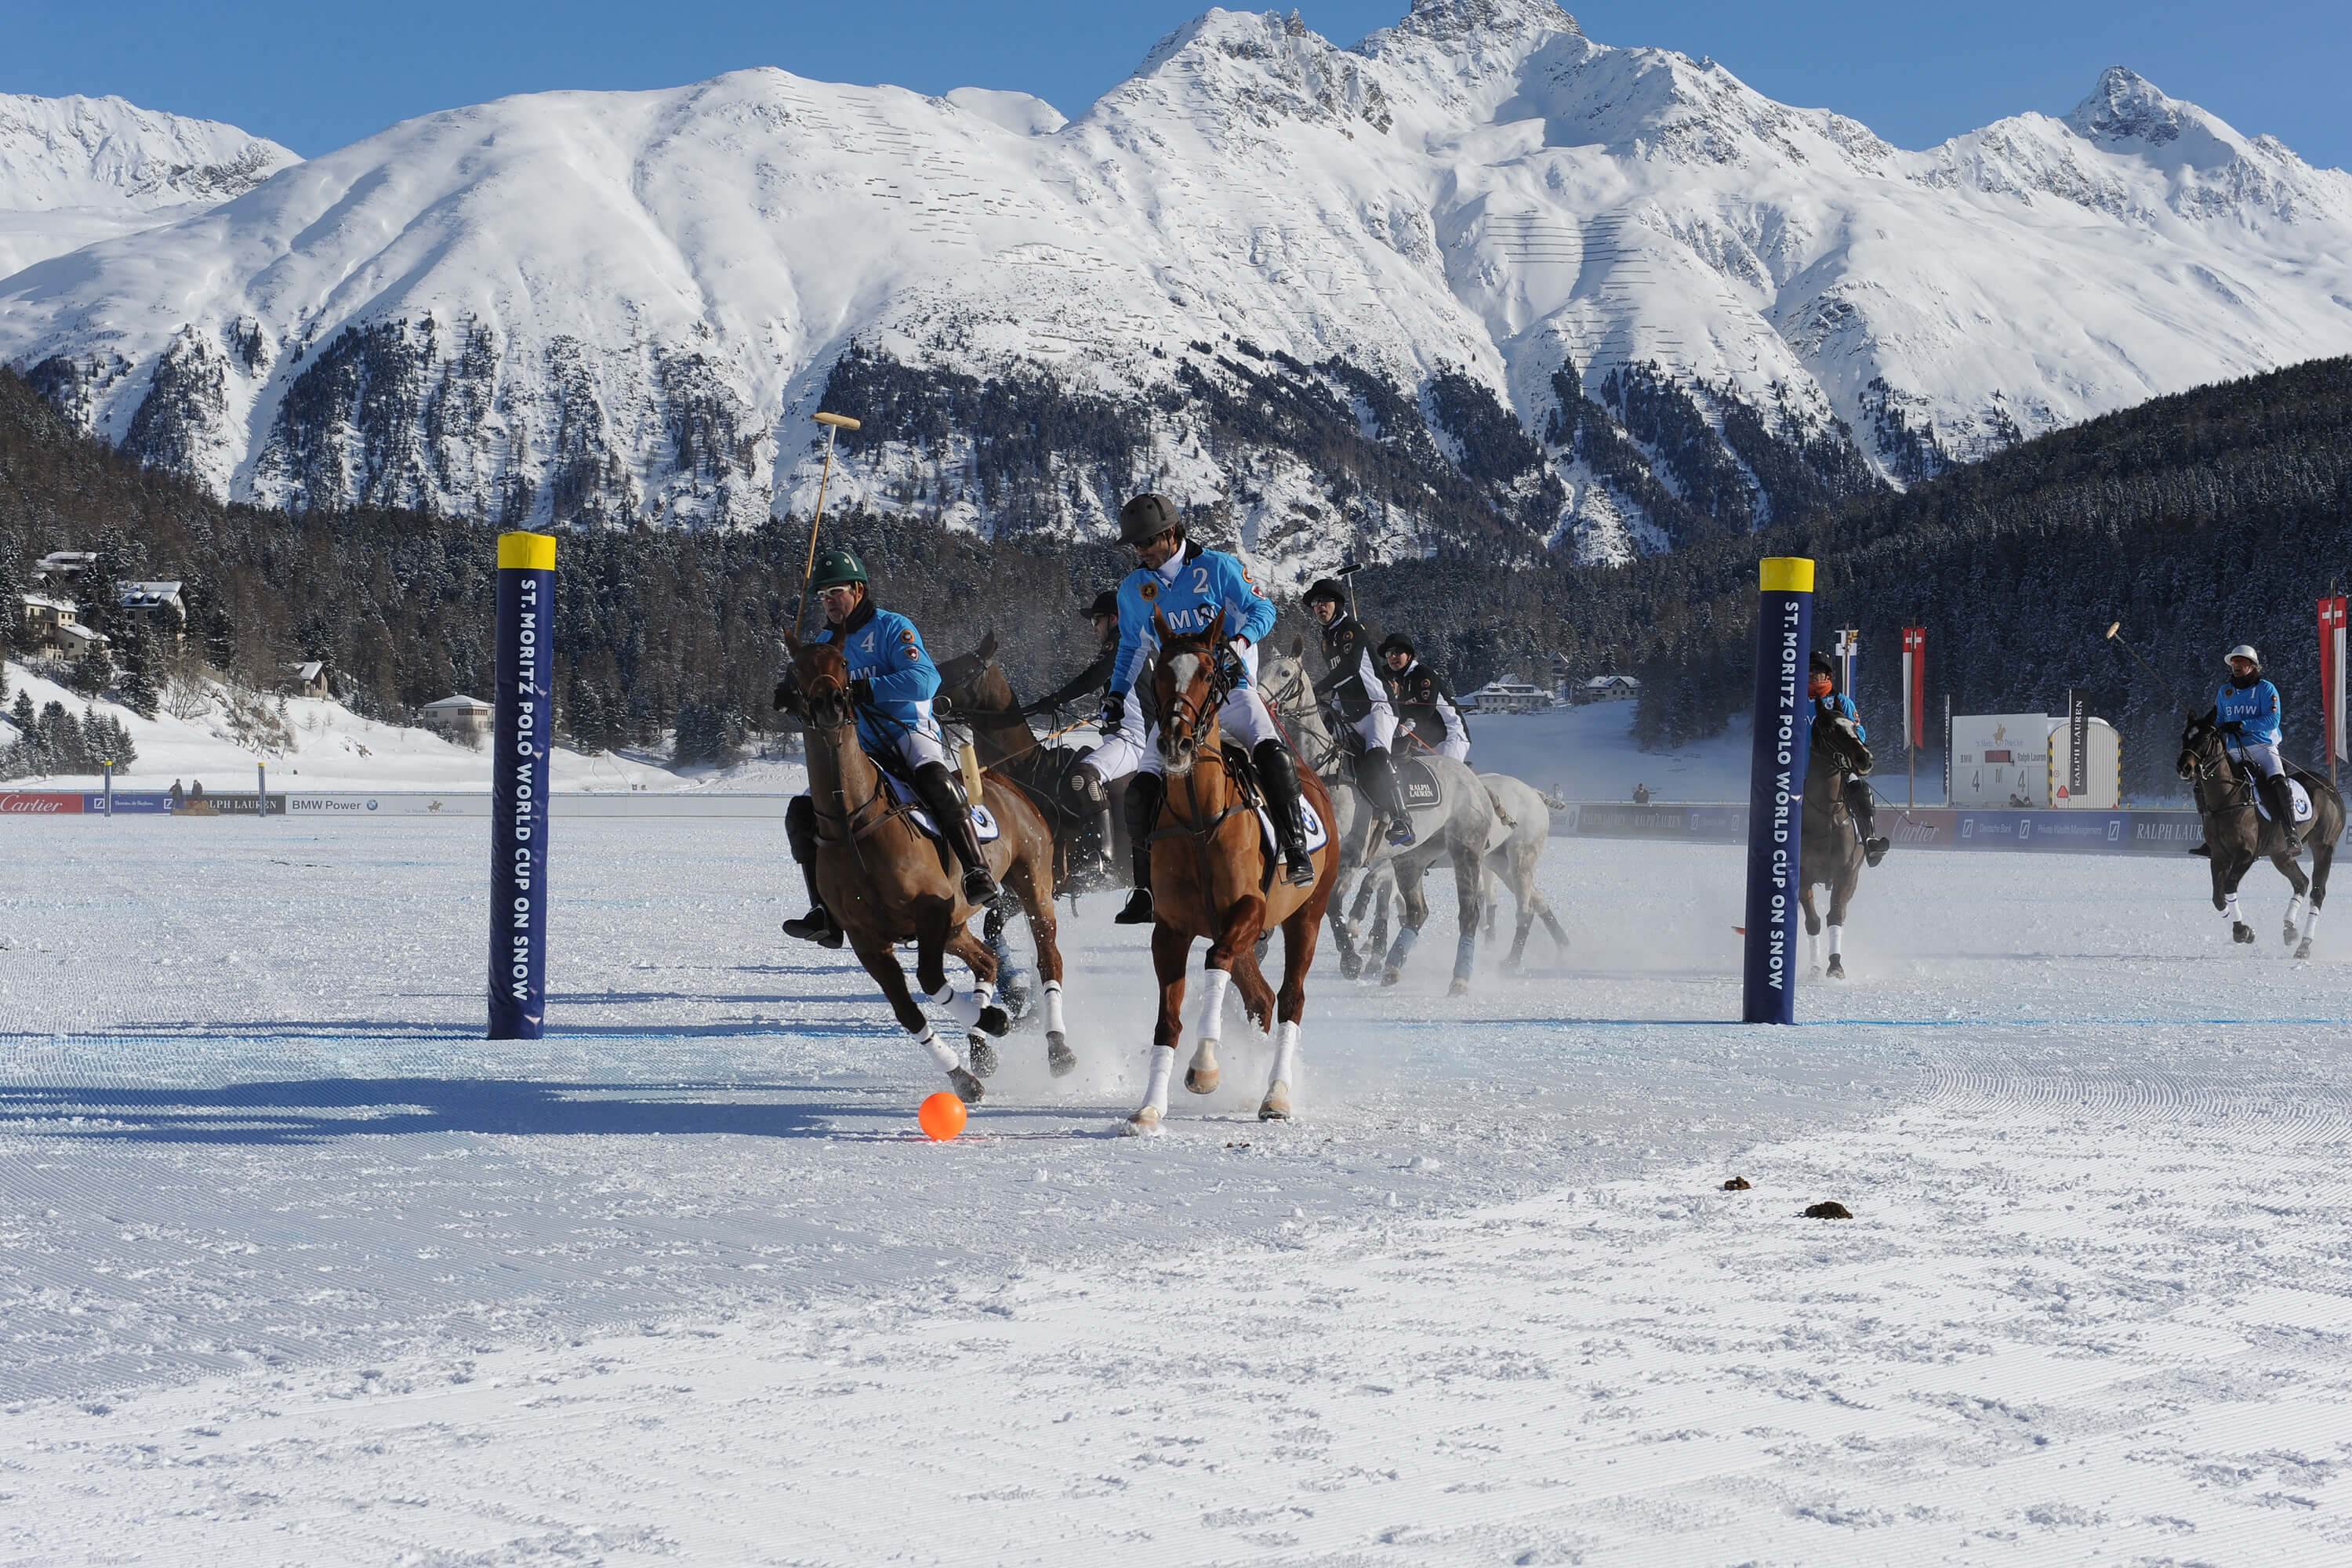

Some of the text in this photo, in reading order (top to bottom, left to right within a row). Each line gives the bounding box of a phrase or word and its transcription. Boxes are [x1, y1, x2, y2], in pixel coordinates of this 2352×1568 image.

[1192, 567, 1209, 593] 2
[1151, 604, 1216, 630] MW
[860, 630, 875, 653] 4
[2249, 687, 2256, 699] 1
[2074, 700, 2083, 745] LAUREN
[2226, 706, 2257, 716] BMW
[517, 702, 532, 756] POLO
[1778, 714, 1793, 764] POLO
[2017, 753, 2046, 764] Ralph Lauren
[1972, 770, 1980, 793] 4
[2017, 770, 2026, 793] 4
[0, 794, 63, 811] Cartier
[292, 800, 361, 810] BMW Power
[515, 763, 532, 840] WORLD
[1775, 771, 1791, 843] WORLD
[1893, 813, 1940, 842] Cartier
[2136, 823, 2205, 841] RALPH LAUR
[514, 848, 531, 891] CUP
[1773, 849, 1787, 888] CUP
[514, 897, 530, 928] ON
[1771, 895, 1785, 923] ON
[513, 935, 528, 1000] SNOW
[1768, 930, 1784, 990] SNOW
